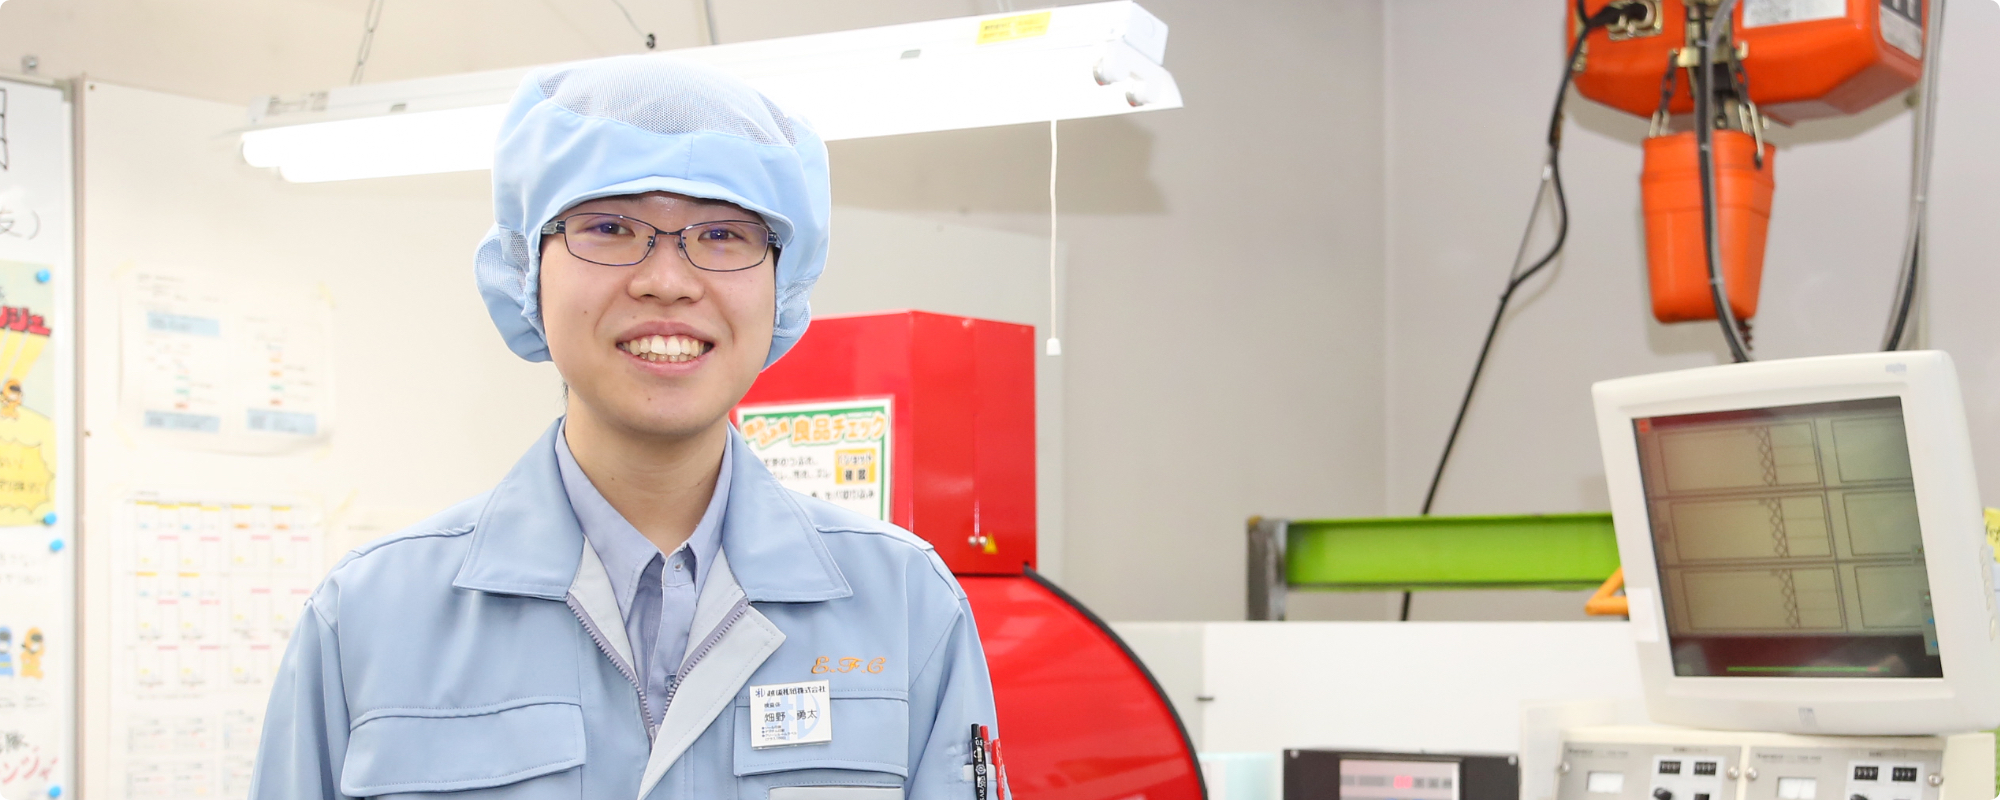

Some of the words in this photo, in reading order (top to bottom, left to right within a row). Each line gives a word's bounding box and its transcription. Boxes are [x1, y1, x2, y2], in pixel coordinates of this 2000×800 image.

[792, 415, 886, 443] 良品チェック
[764, 711, 786, 723] 畑野
[796, 709, 818, 721] 勇太
